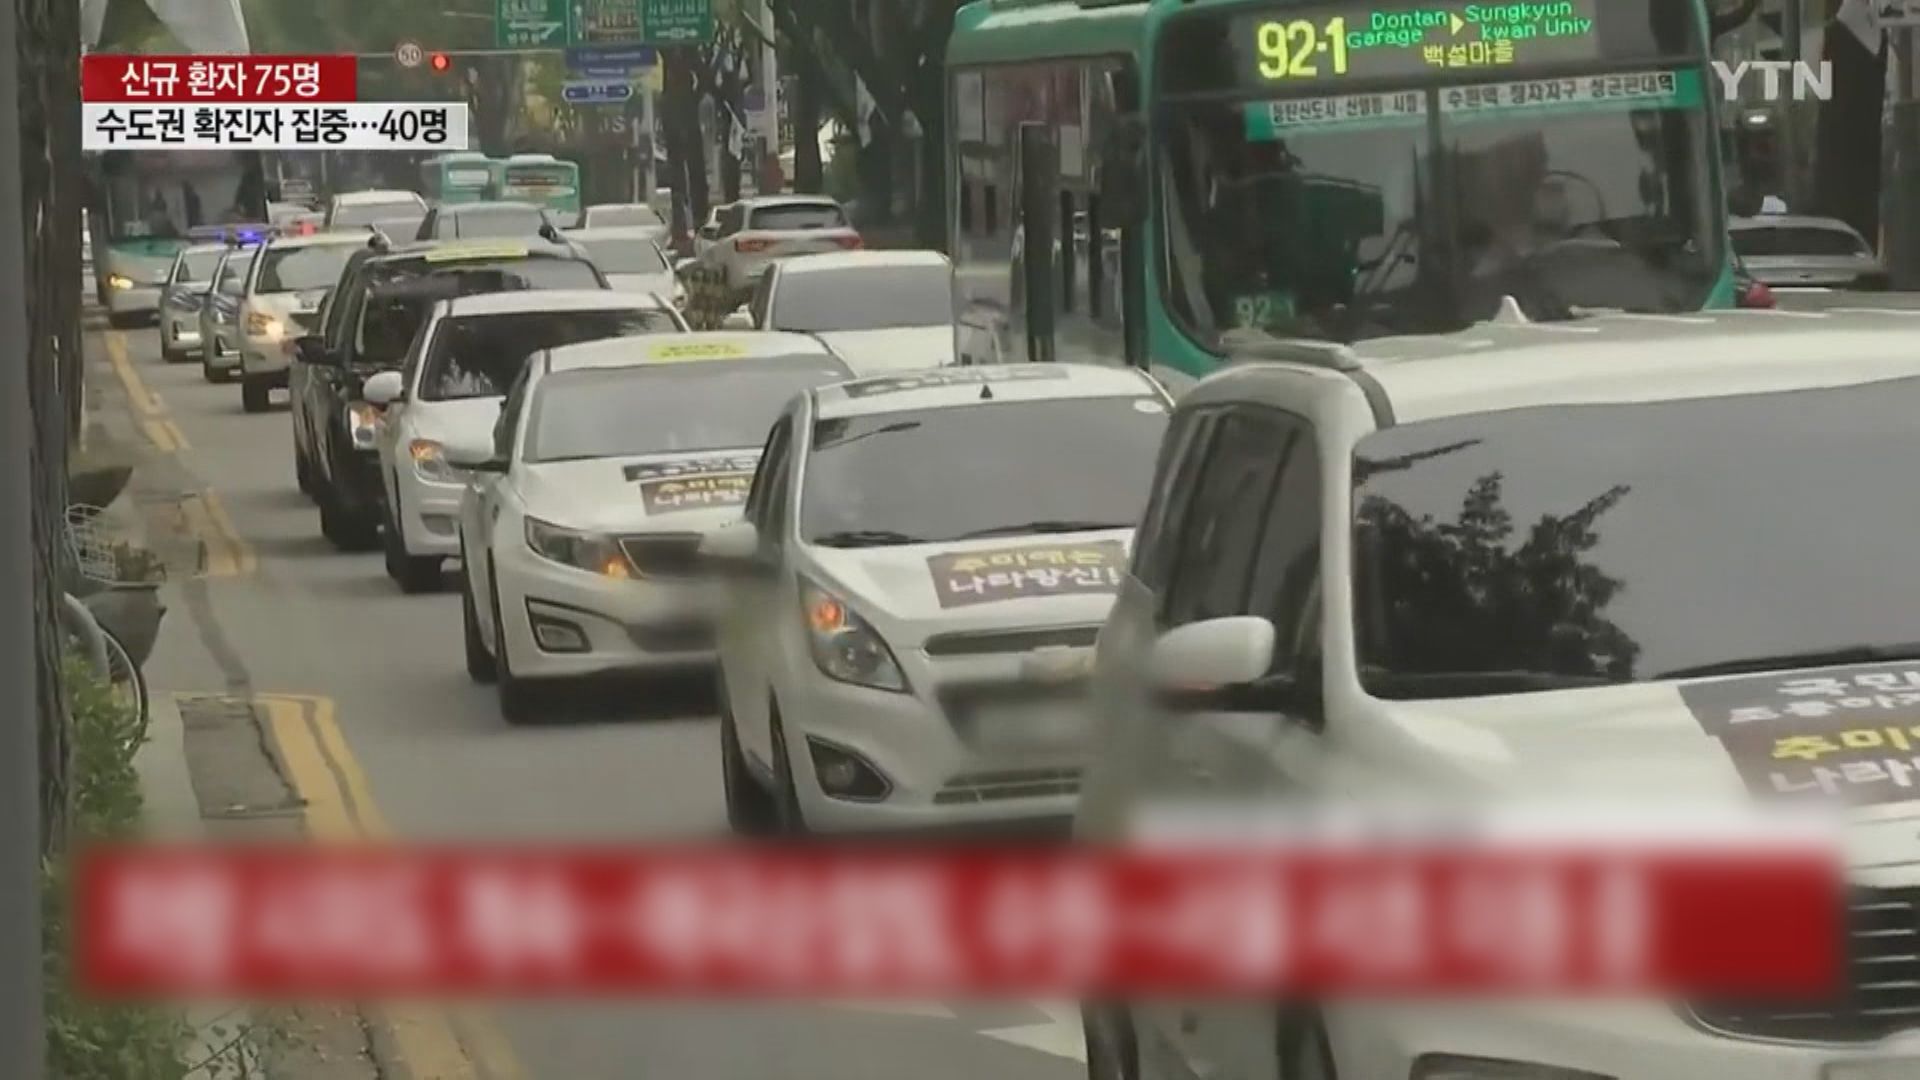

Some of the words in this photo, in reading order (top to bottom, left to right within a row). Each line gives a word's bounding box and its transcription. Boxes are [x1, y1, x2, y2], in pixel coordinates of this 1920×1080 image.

[1371, 10, 1447, 31] Dontan
[1465, 1, 1571, 24] Sungkyun
[1258, 17, 1347, 78] 92-1
[1347, 27, 1423, 48] Garage
[1481, 22, 1536, 41] kwan
[1546, 18, 1592, 36] Univ
[1423, 39, 1514, 67] 백설마을
